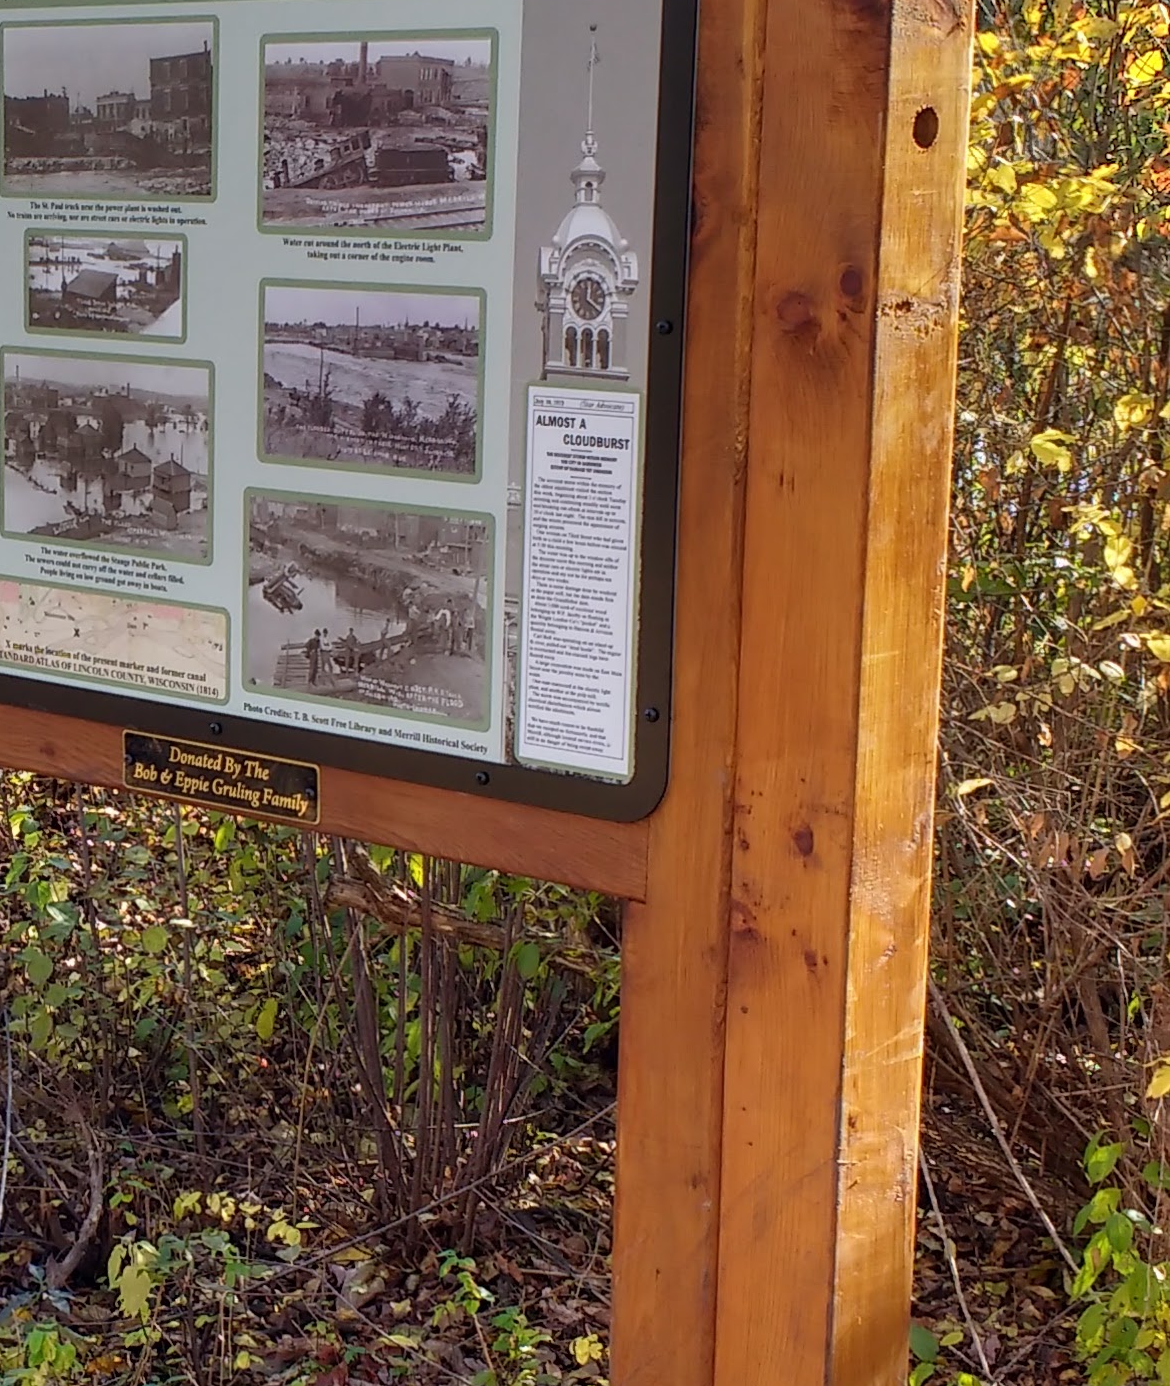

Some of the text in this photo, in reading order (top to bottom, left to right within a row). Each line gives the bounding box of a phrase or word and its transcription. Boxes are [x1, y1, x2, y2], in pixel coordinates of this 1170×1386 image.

[282, 237, 302, 246] Water
[315, 239, 339, 247] around
[340, 239, 351, 248] the
[352, 240, 371, 249] north
[381, 240, 392, 249] the
[393, 241, 420, 250] Electric
[422, 242, 441, 253] Light
[536, 415, 587, 429] ALMOST A
[563, 434, 630, 450] CLOUDBURST
[12, 642, 32, 652] marks
[33, 644, 44, 655] the
[44, 645, 71, 658] location
[80, 653, 91, 662] the
[92, 653, 117, 666] present
[119, 661, 144, 671] marker
[146, 665, 159, 674] and
[161, 666, 185, 678] former
[186, 672, 206, 681] canal
[34, 656, 59, 670] ATLAS
[73, 663, 109, 678] LINCOLN
[147, 675, 194, 691] WISCONSIN
[243, 702, 263, 713] Photo
[311, 714, 329, 725] Scott
[330, 717, 346, 728] Free
[348, 720, 376, 735] Library
[378, 728, 392, 736] and
[394, 728, 420, 741] Merrill
[422, 733, 459, 747] Historical
[460, 740, 487, 754] Society
[168, 746, 270, 781] Donated By The
[133, 762, 309, 817] Bob & Eppie Gruling Family
